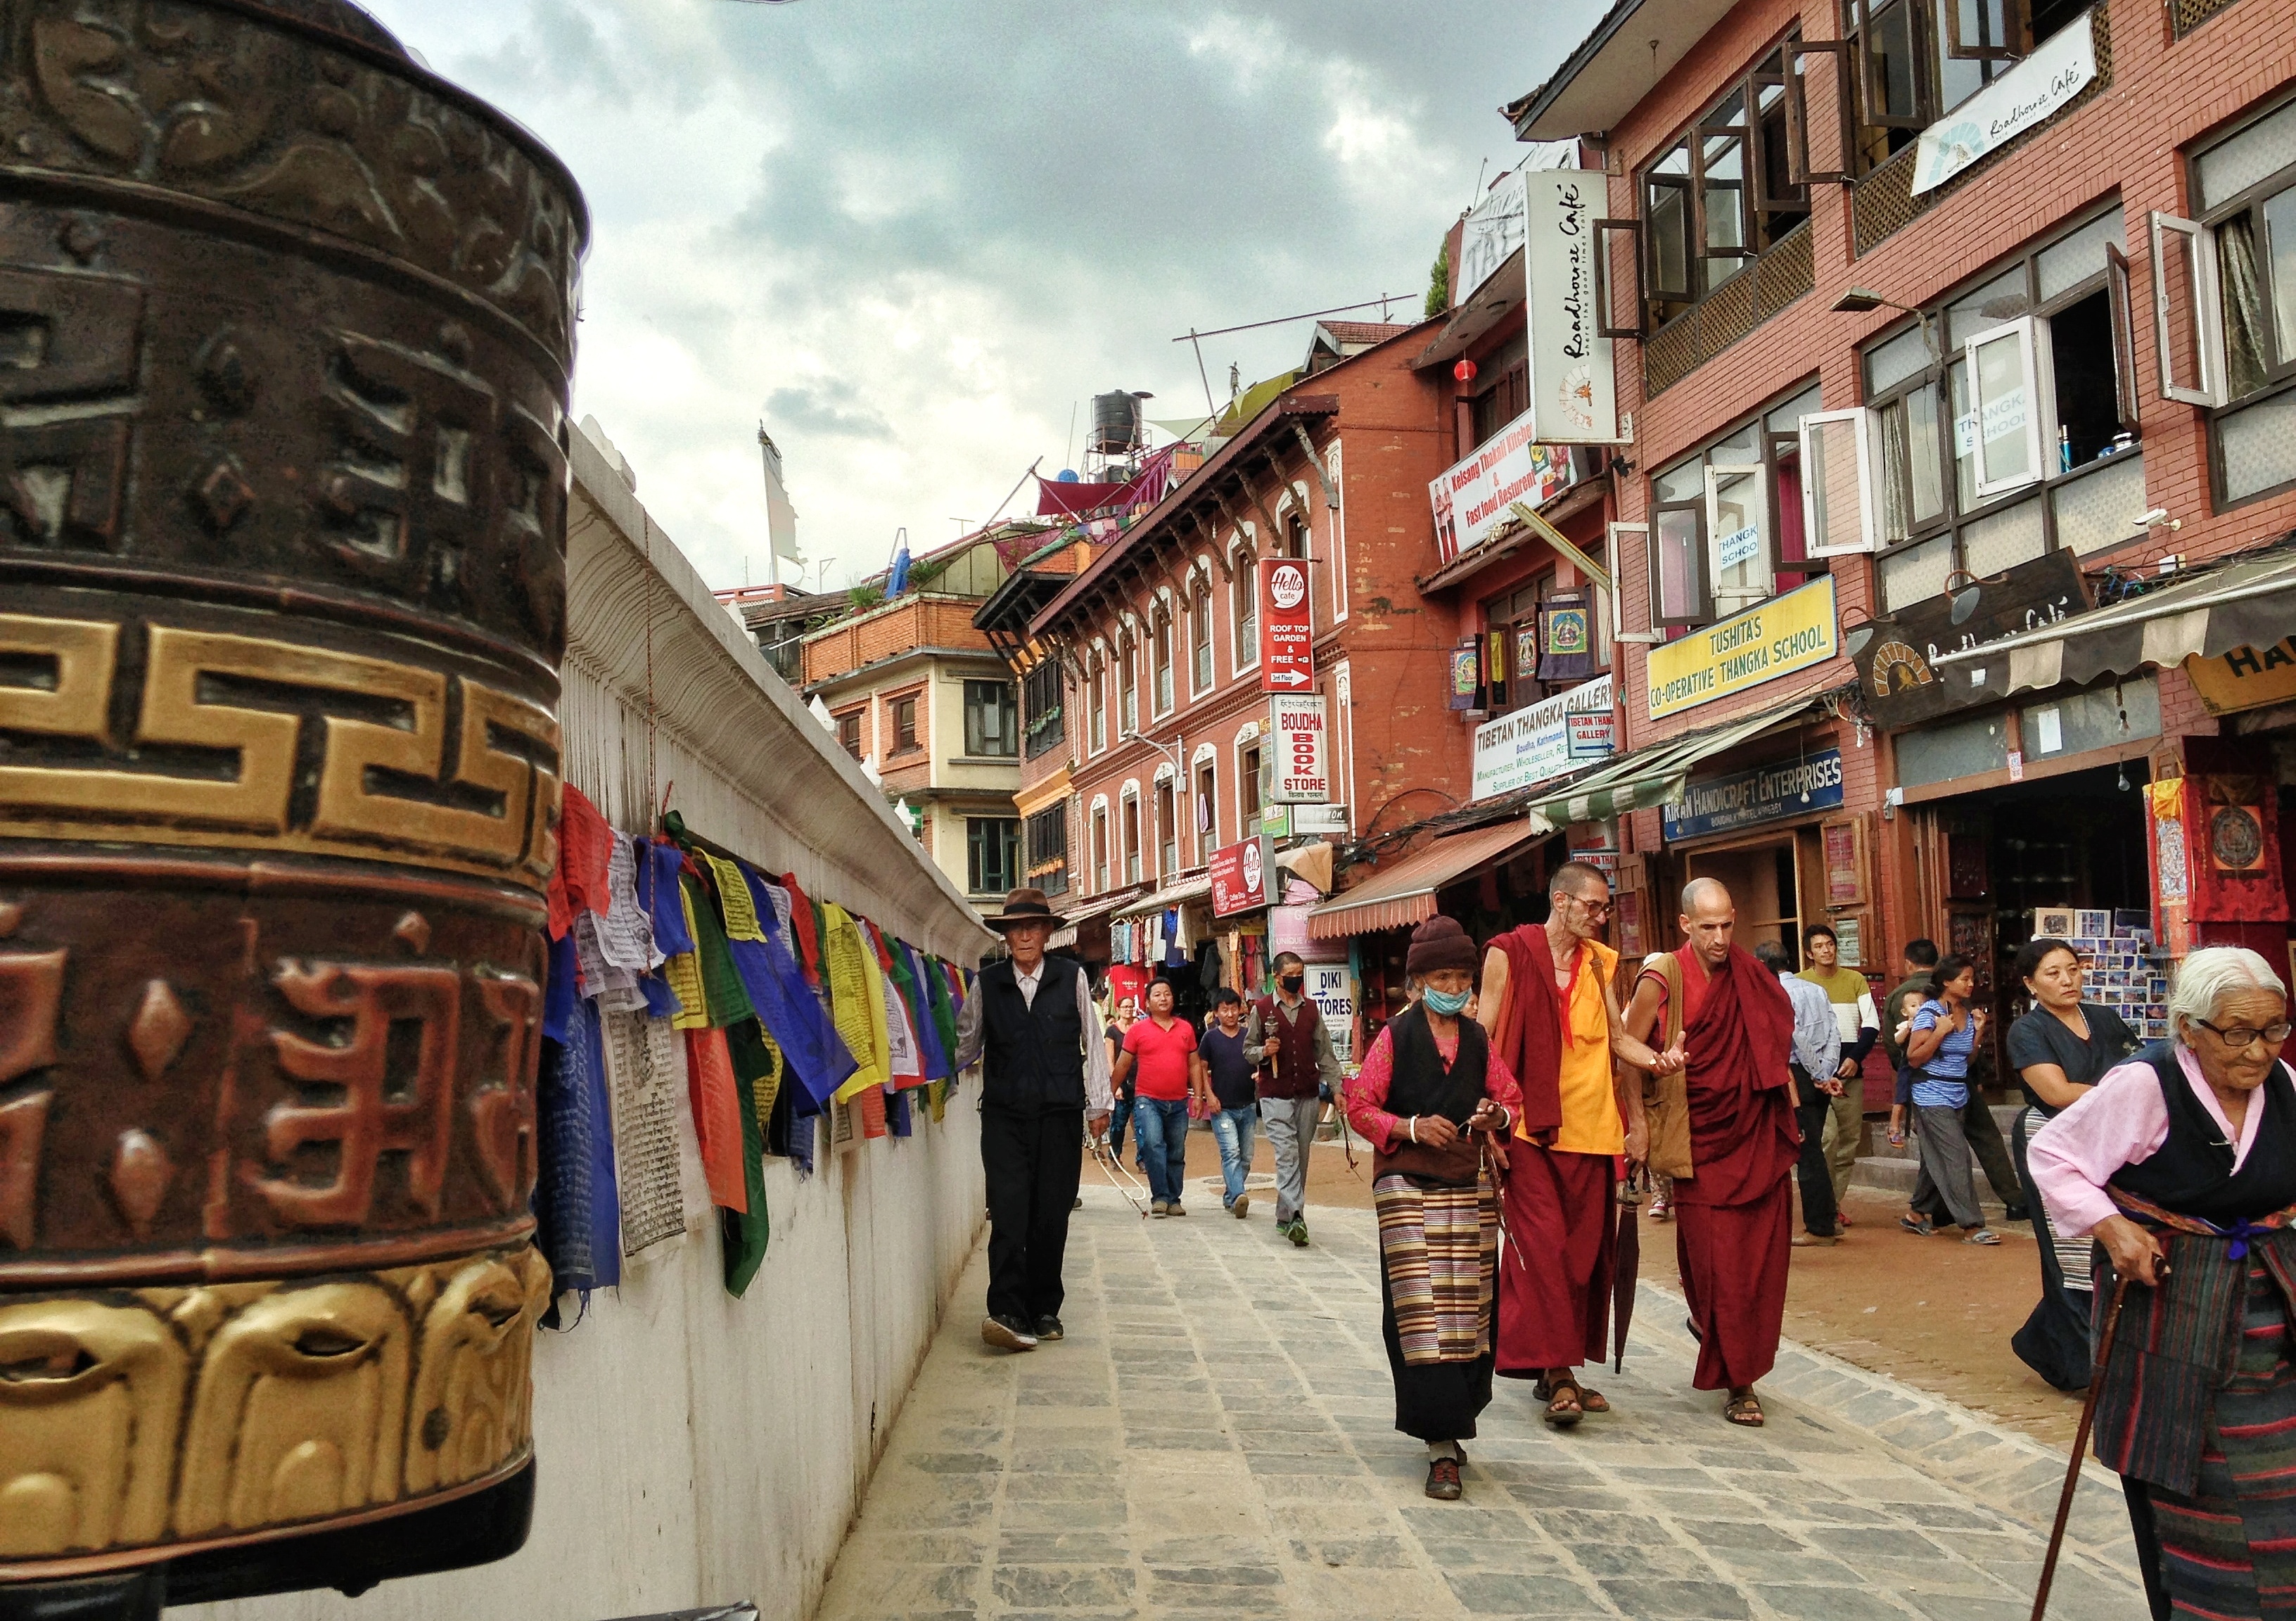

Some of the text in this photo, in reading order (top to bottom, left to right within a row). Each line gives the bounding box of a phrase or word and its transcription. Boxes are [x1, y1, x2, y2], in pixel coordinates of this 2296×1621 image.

[1990, 61, 2079, 139] Roadhouse Café
[1557, 183, 1586, 359] Roadhouse Café
[1451, 422, 1532, 492] Kelsang Thakali Kitche
[1493, 471, 1500, 487] &
[1465, 505, 1482, 528] Fast
[1481, 492, 1498, 519] food
[1719, 526, 1757, 551] THANGK
[1722, 542, 1757, 564] SCHOO
[1270, 571, 1305, 592] Hello
[1709, 616, 1762, 657] TUSHITA'S
[1270, 655, 1294, 663] FREE
[1287, 645, 1294, 654] &
[1650, 623, 1828, 708] CO-OPERATIVE THANGKA SCHOOL
[1281, 713, 1323, 731] BOUDHA
[1477, 720, 1514, 753] TIBETAN
[1517, 701, 1564, 736] THANGKA
[1568, 715, 1614, 727] TIBETAN THANG
[1576, 730, 1610, 740] GALLERY
[1292, 732, 1315, 775] BOOK
[1284, 778, 1326, 791] STORE
[1693, 778, 1757, 817] HANDICRAFT
[1759, 757, 1842, 802] ENTERPRISES
[1243, 850, 1261, 873] Hello
[1276, 936, 1303, 945] UNIQUE
[1320, 972, 1341, 989] DIKI
[1317, 998, 1352, 1015] TORES
